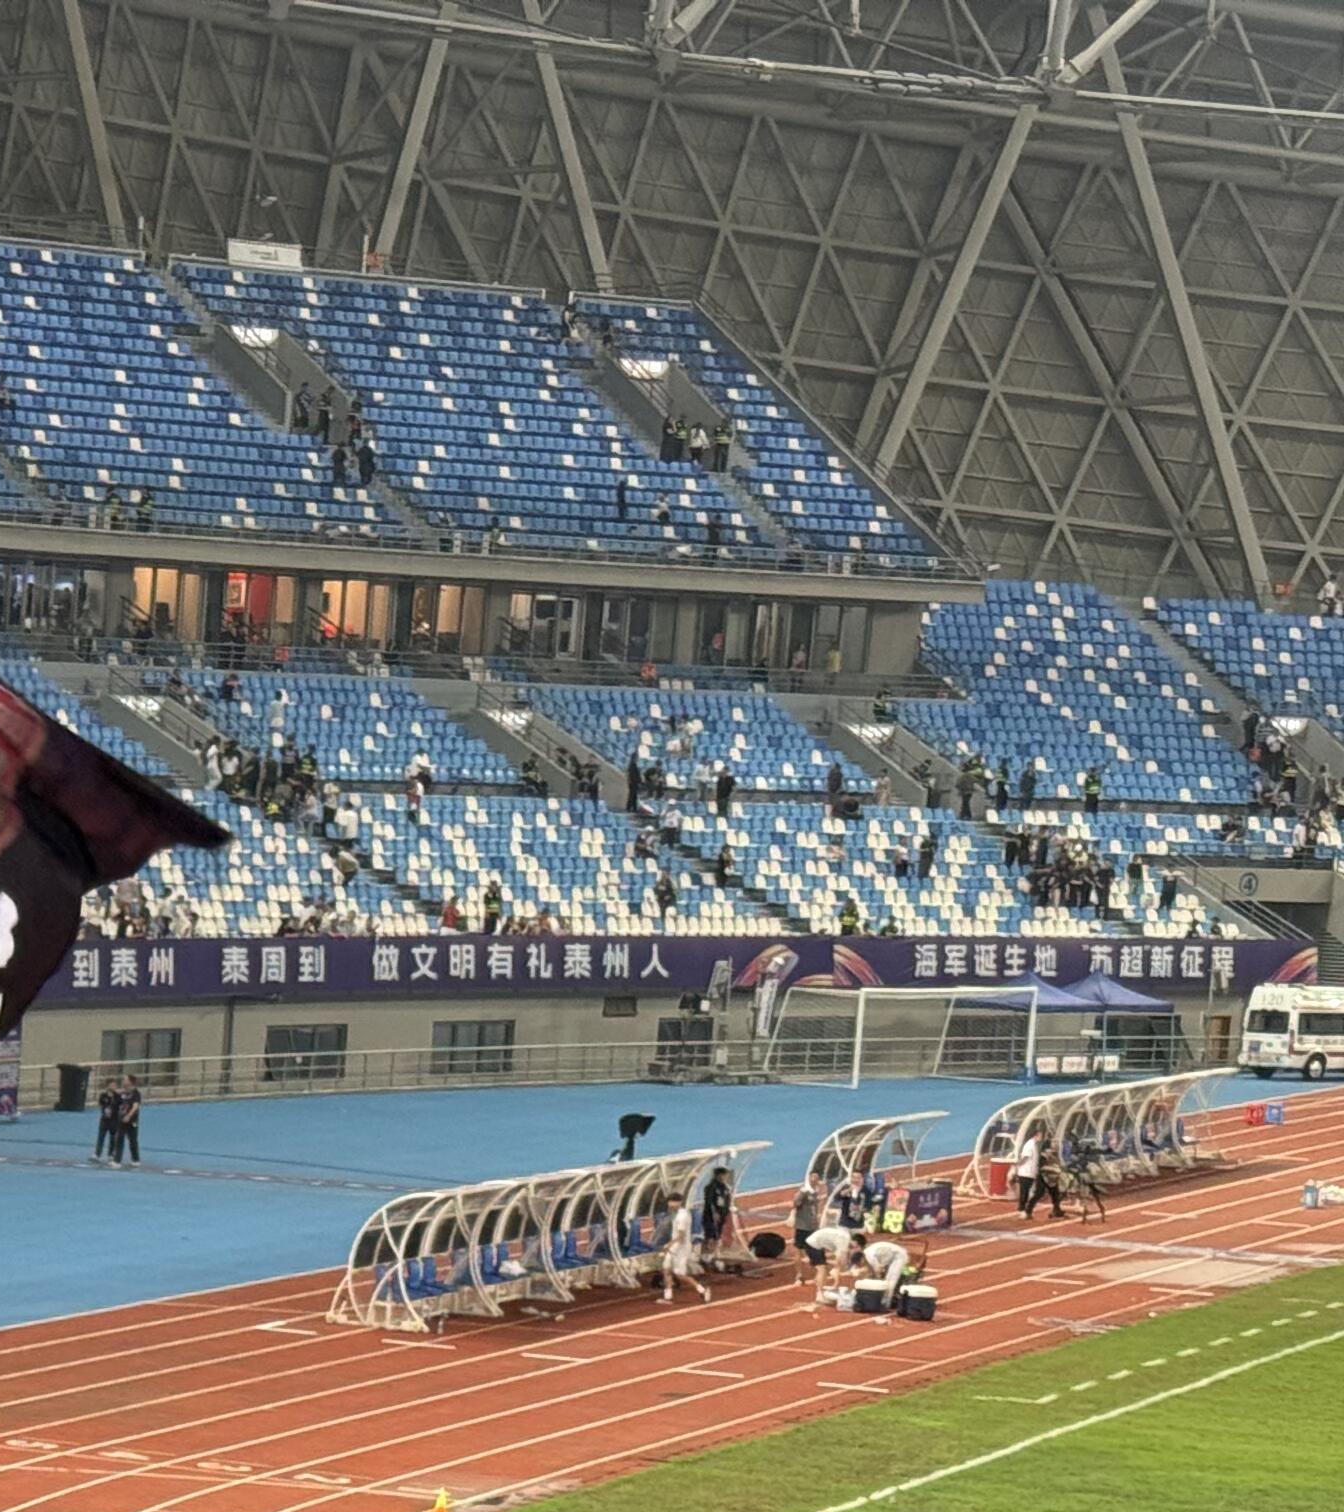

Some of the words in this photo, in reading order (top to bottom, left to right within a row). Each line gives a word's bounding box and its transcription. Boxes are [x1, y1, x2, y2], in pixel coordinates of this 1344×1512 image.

[73, 947, 175, 988] 到泰州
[221, 945, 325, 984] 泰周到
[372, 943, 670, 982] 做文明有礼泰州人
